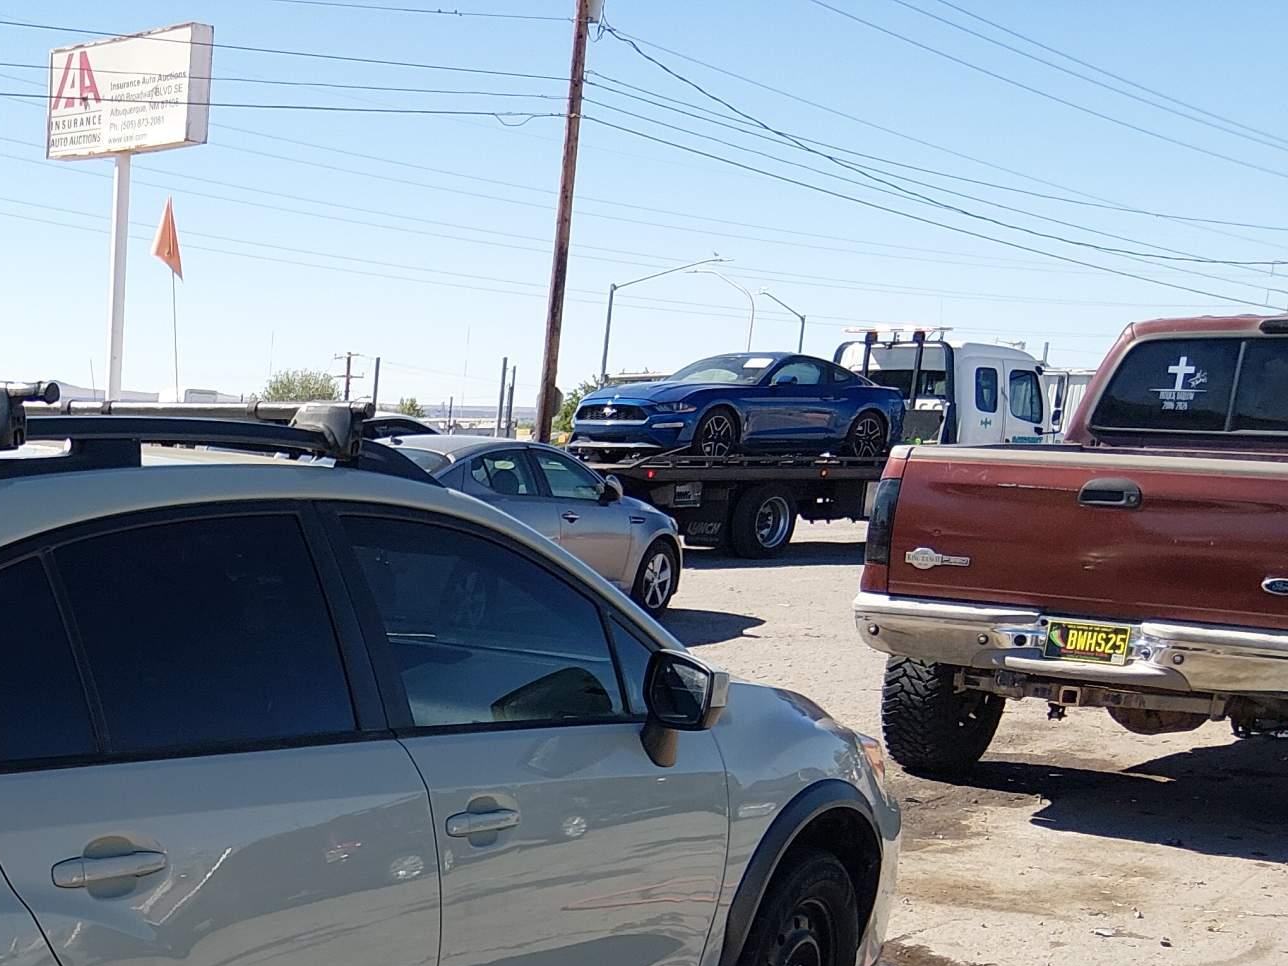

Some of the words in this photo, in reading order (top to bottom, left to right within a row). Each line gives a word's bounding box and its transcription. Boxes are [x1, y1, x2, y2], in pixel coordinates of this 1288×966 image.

[110, 80, 141, 91] Insurance
[142, 76, 156, 85] Auto
[157, 71, 187, 82] Auctions
[174, 84, 184, 93] SE
[51, 115, 102, 131] INSURANCE
[51, 134, 68, 147] AUTO
[69, 131, 101, 146] AUCTIONS
[1066, 630, 1127, 654] BWHS25
